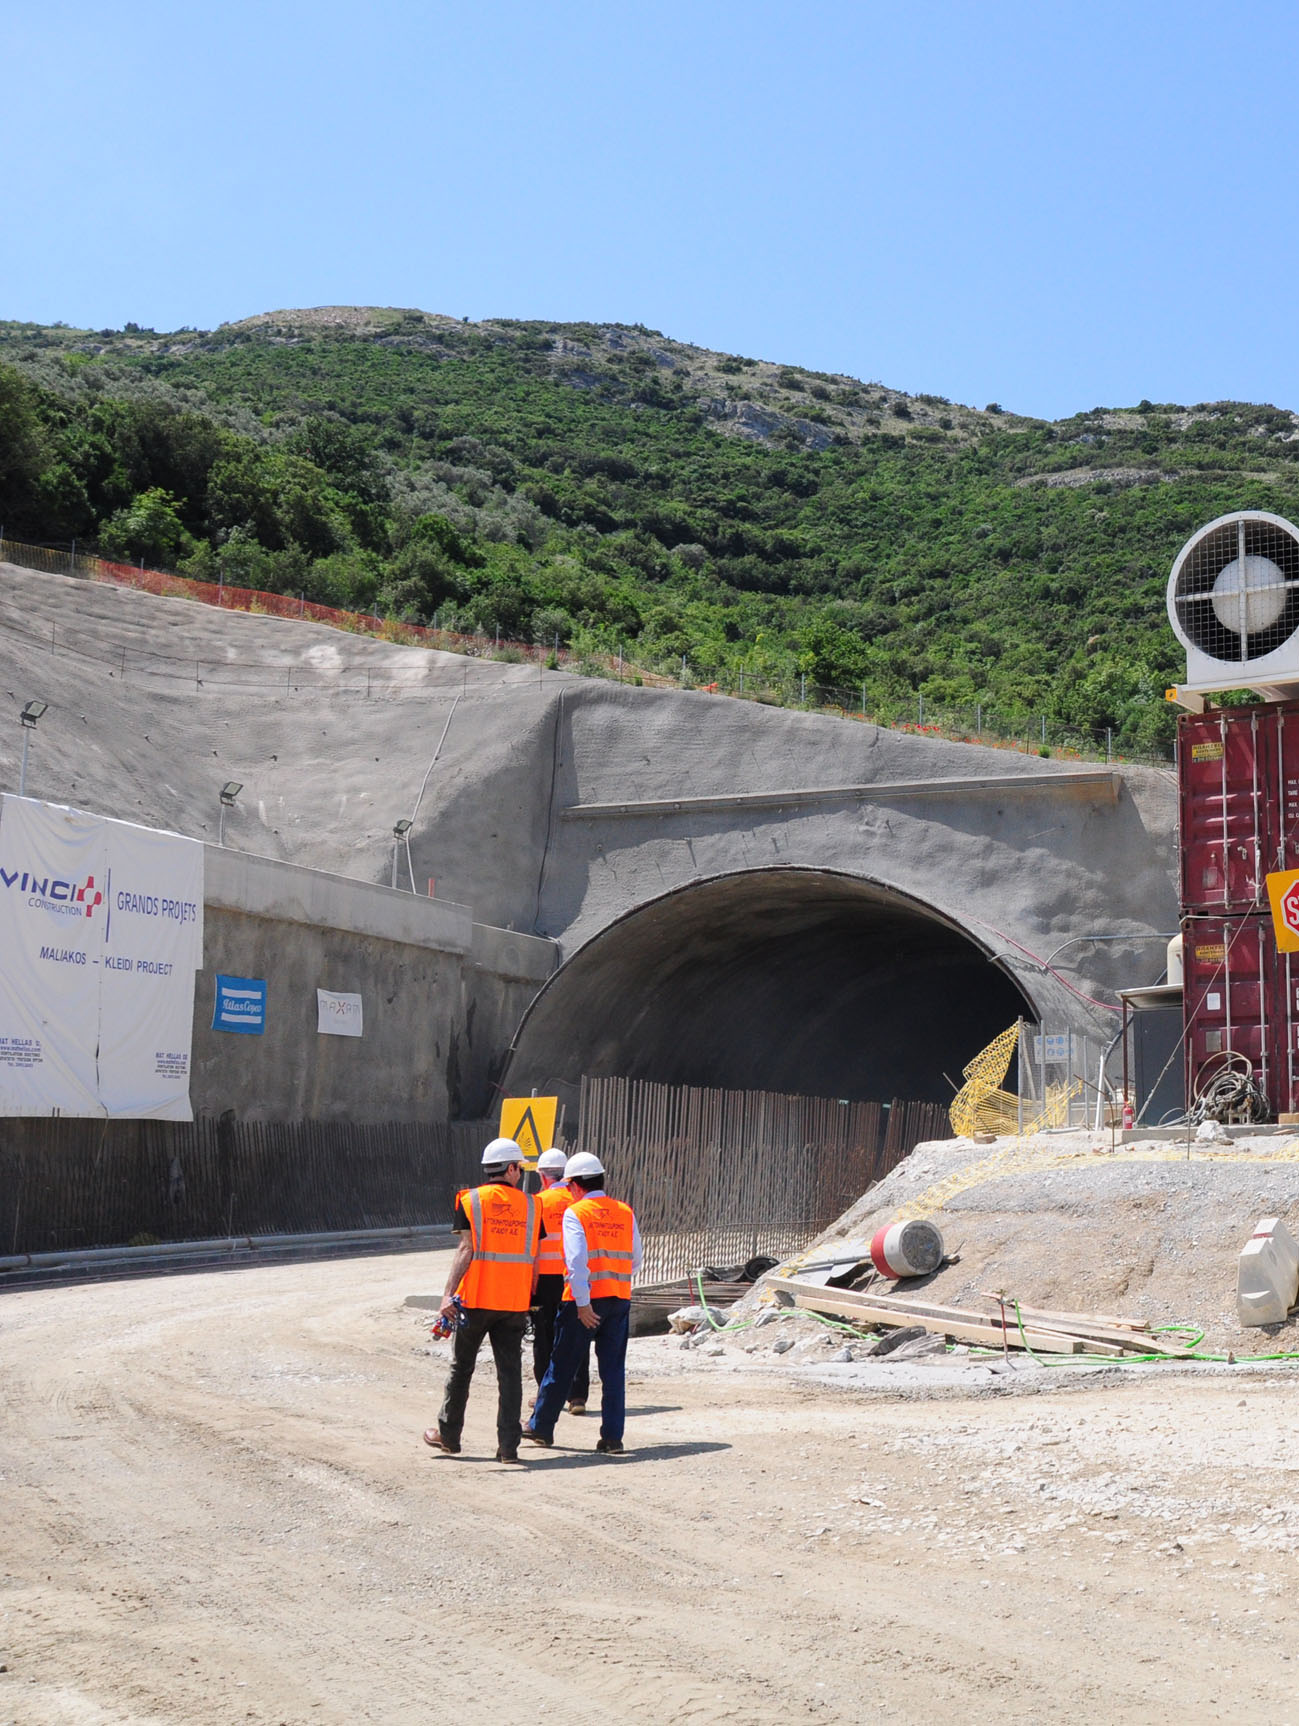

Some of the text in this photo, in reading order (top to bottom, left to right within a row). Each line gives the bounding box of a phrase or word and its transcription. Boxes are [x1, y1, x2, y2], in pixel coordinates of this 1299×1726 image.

[0, 867, 77, 902] VINCI
[28, 897, 82, 916] CONSTRUCTION
[117, 891, 196, 925] GRANDS PROJETS
[39, 946, 87, 965] MALIAKOS
[105, 956, 133, 972] KLEIDI
[136, 960, 173, 976] PROJECT
